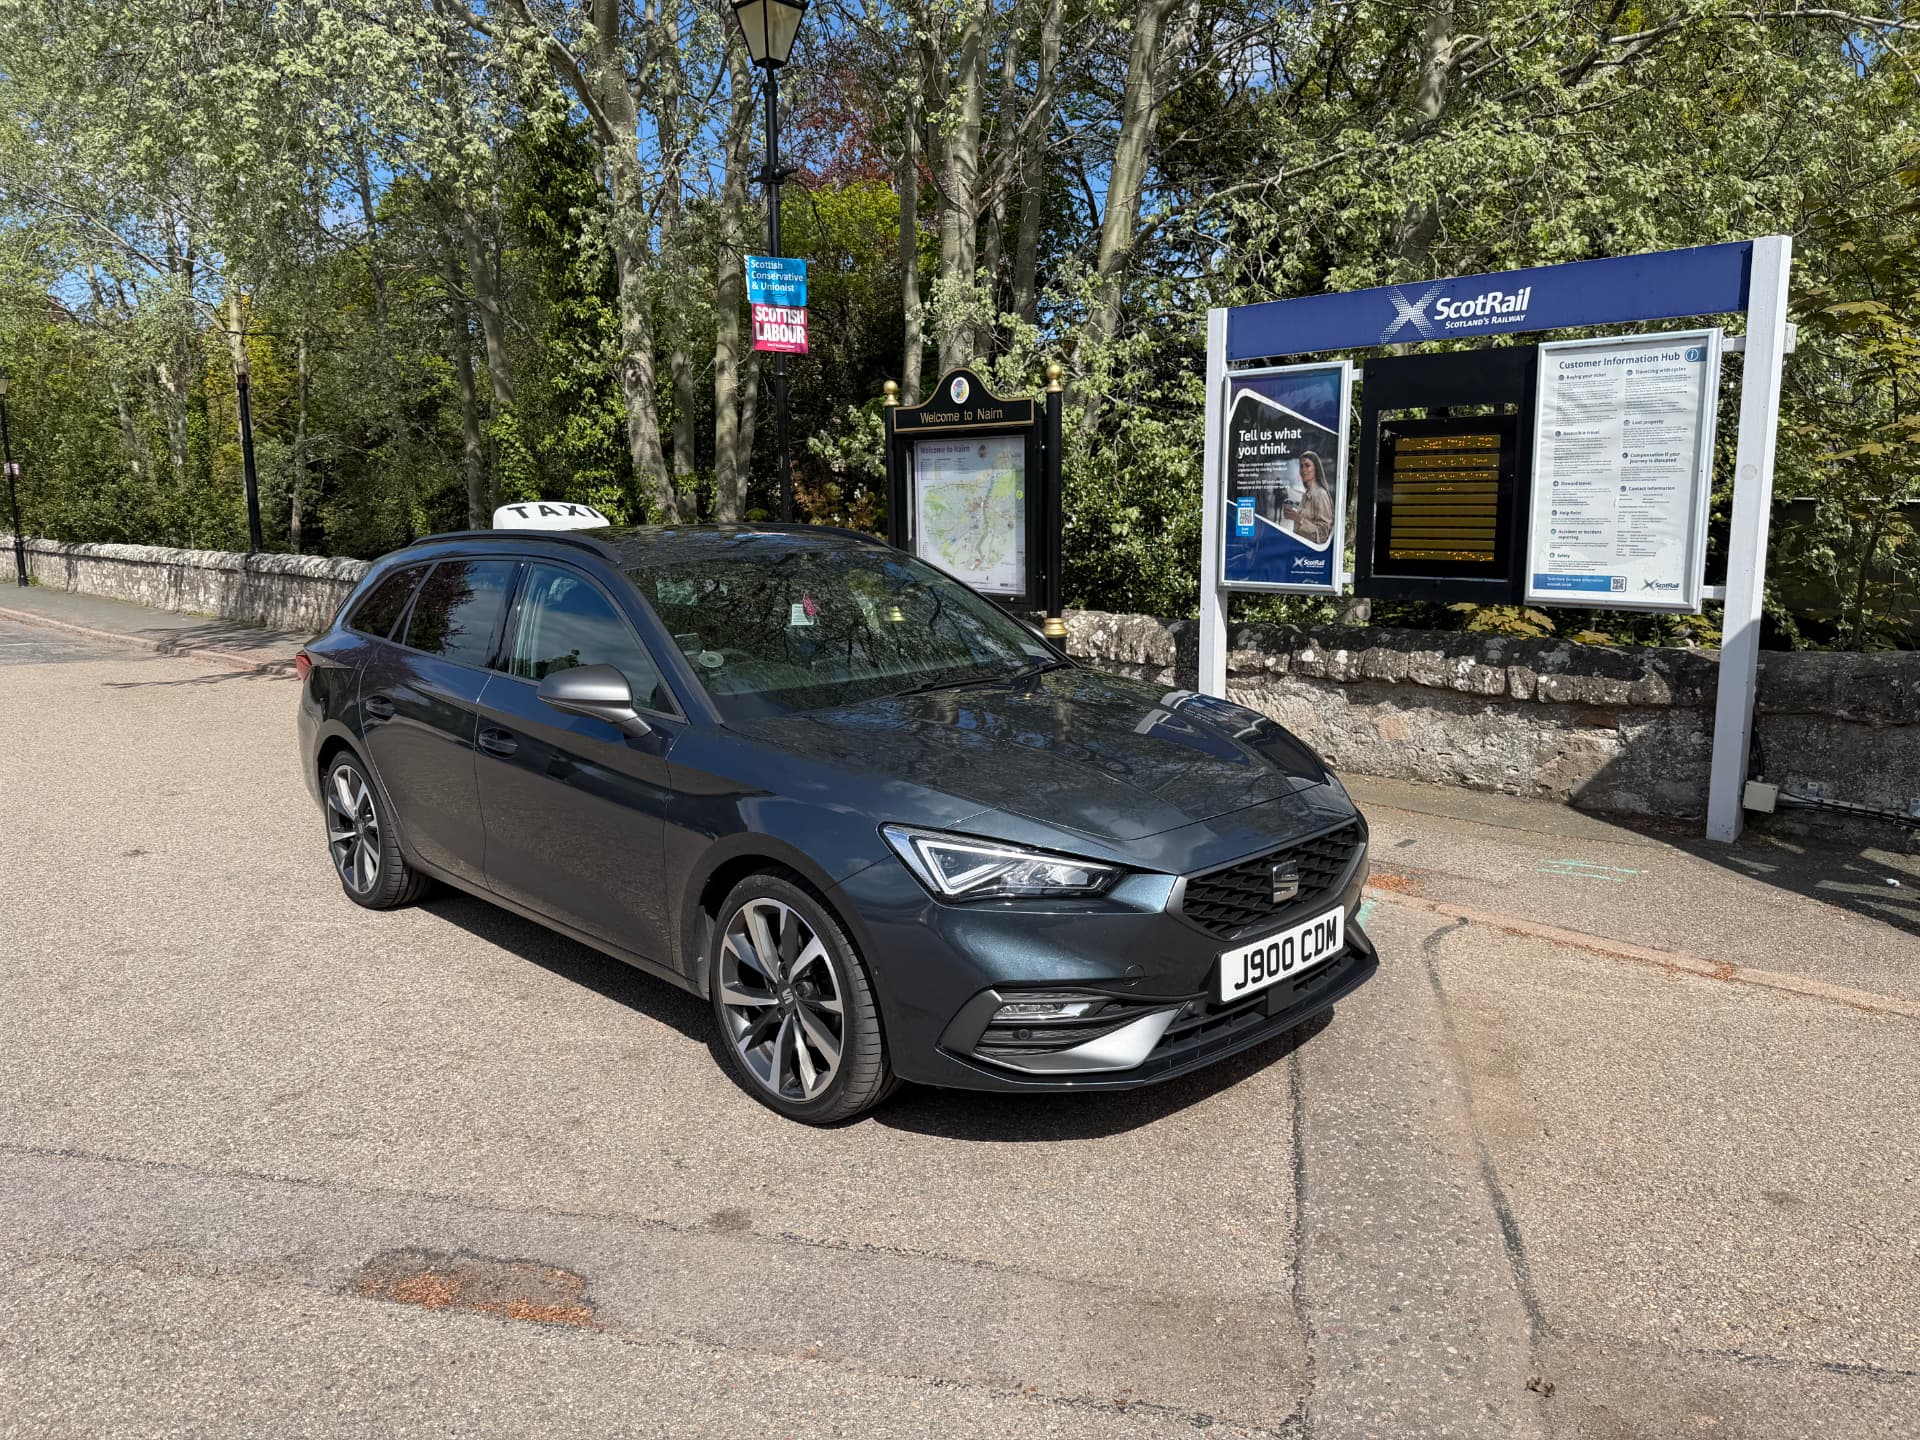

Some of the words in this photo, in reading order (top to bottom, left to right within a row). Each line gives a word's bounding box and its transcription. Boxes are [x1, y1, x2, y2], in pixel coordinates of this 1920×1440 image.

[750, 260, 783, 270] Scottish
[751, 271, 804, 282] Conservative
[751, 282, 759, 290] &
[760, 282, 795, 292] Unionist
[1434, 287, 1531, 320] ScotRail
[755, 306, 804, 325] SCOTTISH
[1445, 317, 1490, 329] SCOTLAND'S
[1491, 314, 1526, 324] RAILWAY
[756, 323, 806, 344] LABOUR
[1559, 360, 1601, 369] Customer
[1604, 354, 1658, 366] Information
[1661, 352, 1680, 361] Hub
[920, 412, 960, 424] Welcome
[964, 410, 973, 420] to
[977, 408, 1003, 420] Nairn
[1238, 429, 1258, 442] Tell
[1260, 432, 1272, 440] us
[1274, 427, 1302, 440] what
[1238, 446, 1257, 459] you
[1260, 442, 1290, 455] think.
[507, 504, 600, 519] TAXI
[1234, 936, 1294, 990] J900
[1301, 915, 1337, 962] CDM
